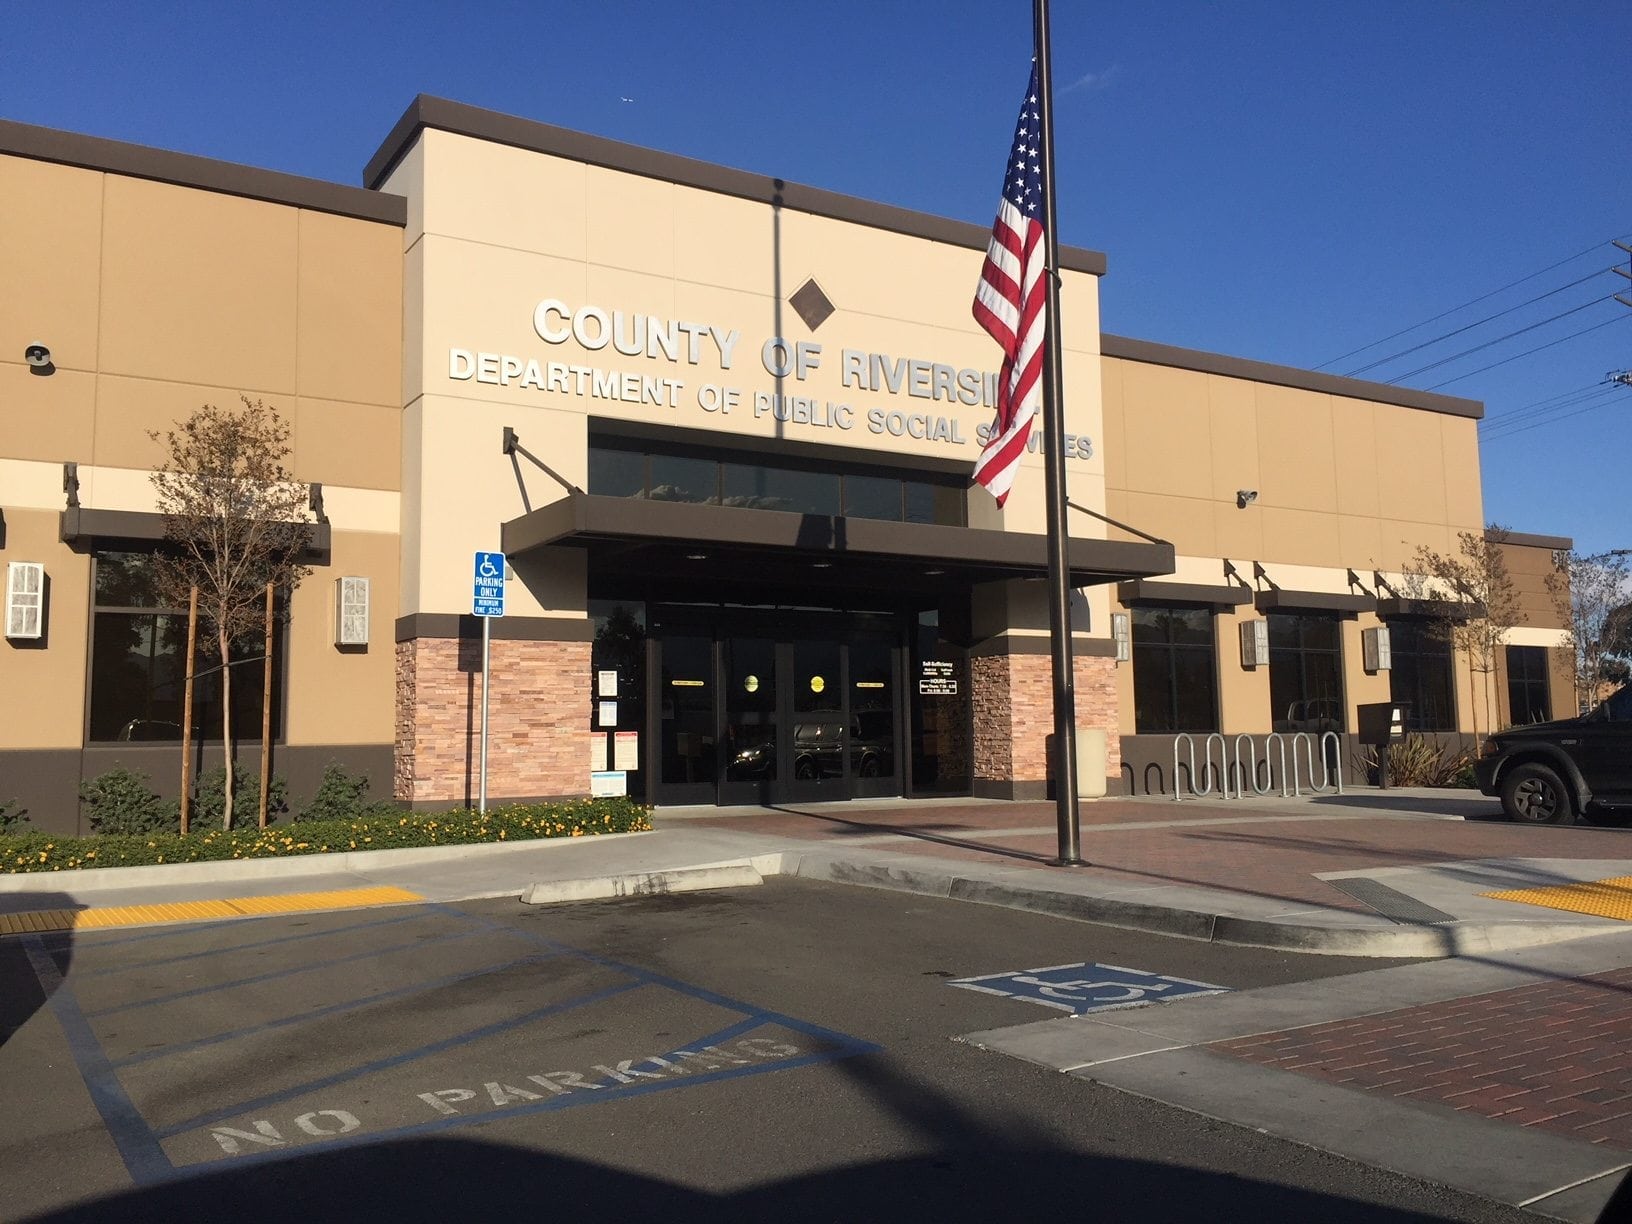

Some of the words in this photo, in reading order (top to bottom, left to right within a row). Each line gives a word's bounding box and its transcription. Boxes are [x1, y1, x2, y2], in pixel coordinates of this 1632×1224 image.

[449, 348, 682, 408] DEPARTMENT
[698, 383, 740, 414] OF
[754, 391, 853, 429] PUBLIC
[867, 408, 965, 444] SOCIAL
[976, 423, 1093, 460] SVIES
[533, 299, 739, 370] COUNTY
[762, 336, 822, 381] OF
[842, 348, 1040, 414] RIVERSI
[475, 576, 503, 588] PARKING
[480, 587, 497, 597] ONLY
[211, 1109, 361, 1154] NO
[417, 1038, 799, 1114] PARKING
